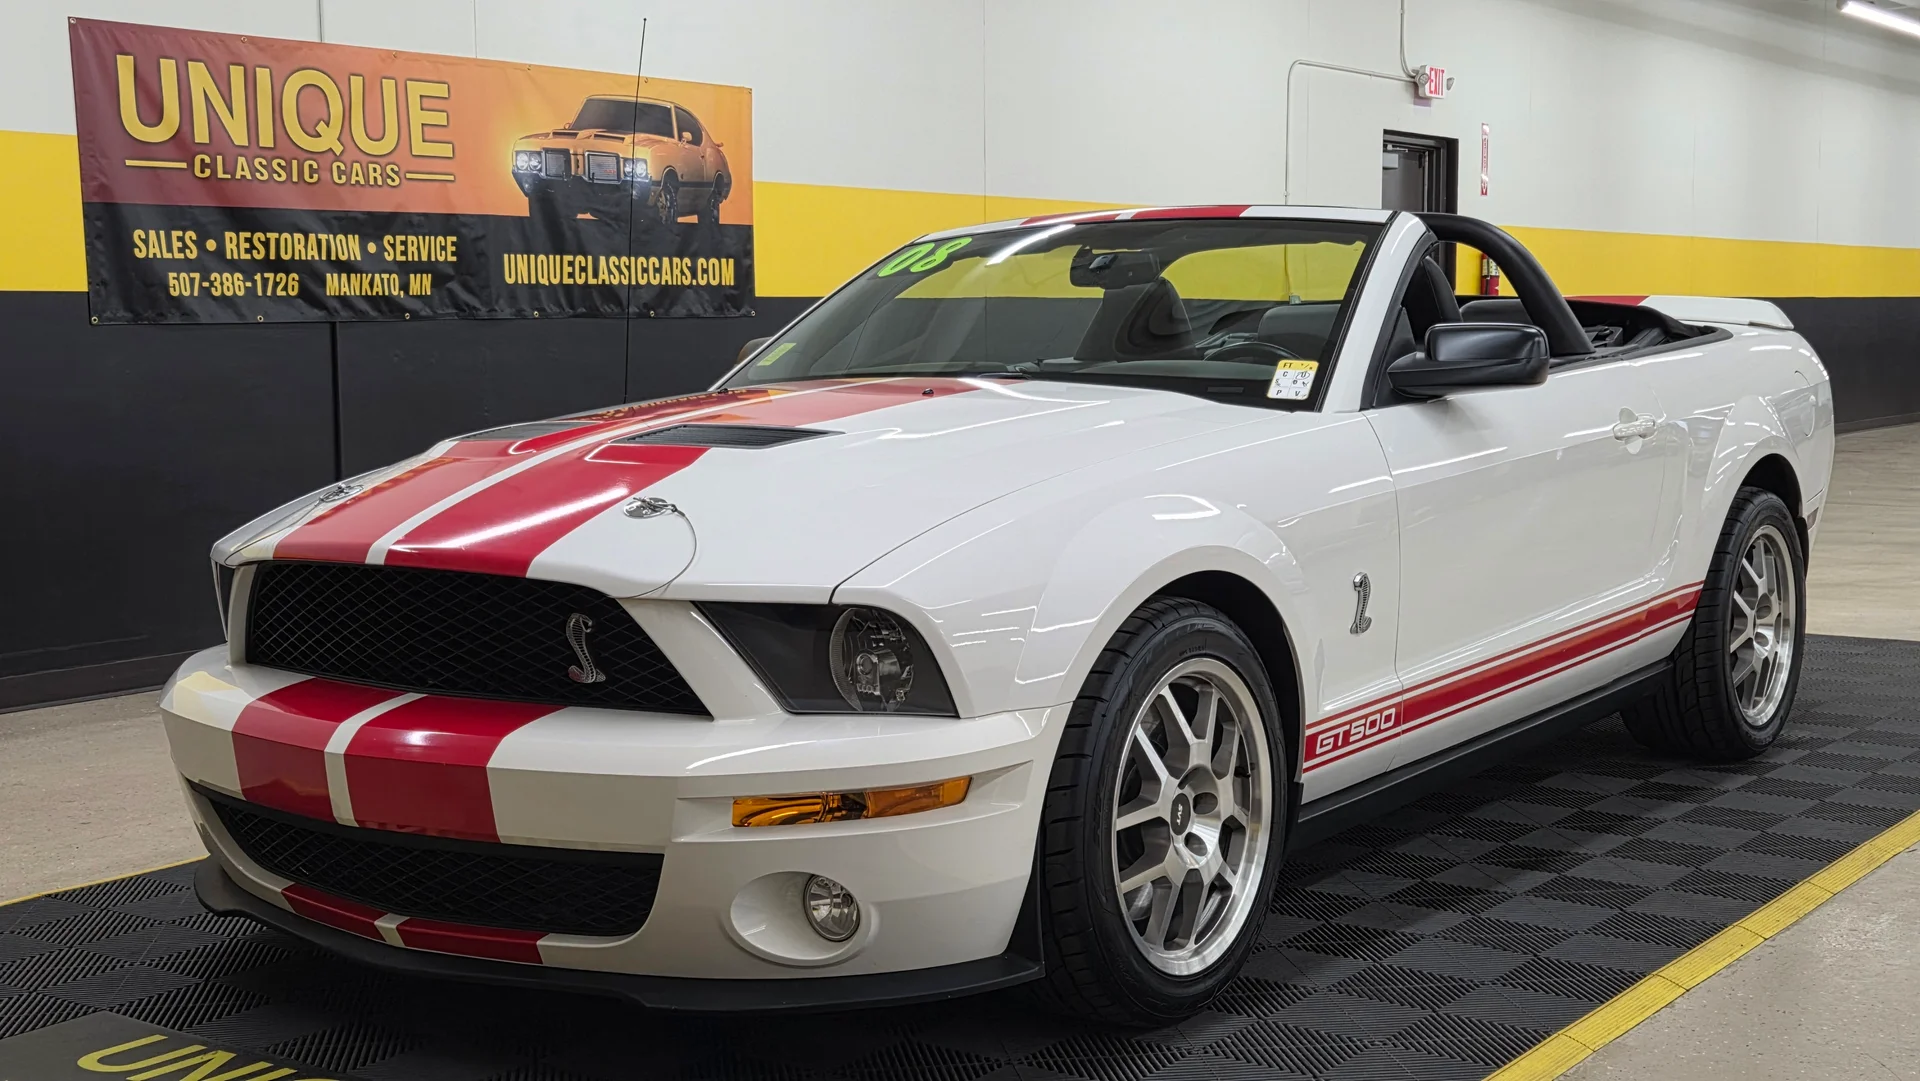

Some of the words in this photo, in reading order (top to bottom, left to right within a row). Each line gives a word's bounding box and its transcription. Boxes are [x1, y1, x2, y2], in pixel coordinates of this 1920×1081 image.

[1428, 67, 1445, 96] EXIT
[116, 54, 454, 157] UNIQUE
[193, 153, 320, 184] CLASSIC
[332, 161, 401, 187] CARS
[133, 229, 198, 260] SALES
[225, 231, 361, 262] RESTORATION
[384, 234, 458, 263] SERVICE
[878, 237, 973, 277] 08
[168, 272, 299, 298] 507-386-1726
[326, 272, 404, 299] MANKATO,
[409, 272, 432, 297] MN
[503, 253, 735, 287] UNIQUECLASSICCARS.COM
[1315, 707, 1396, 755] GT500
